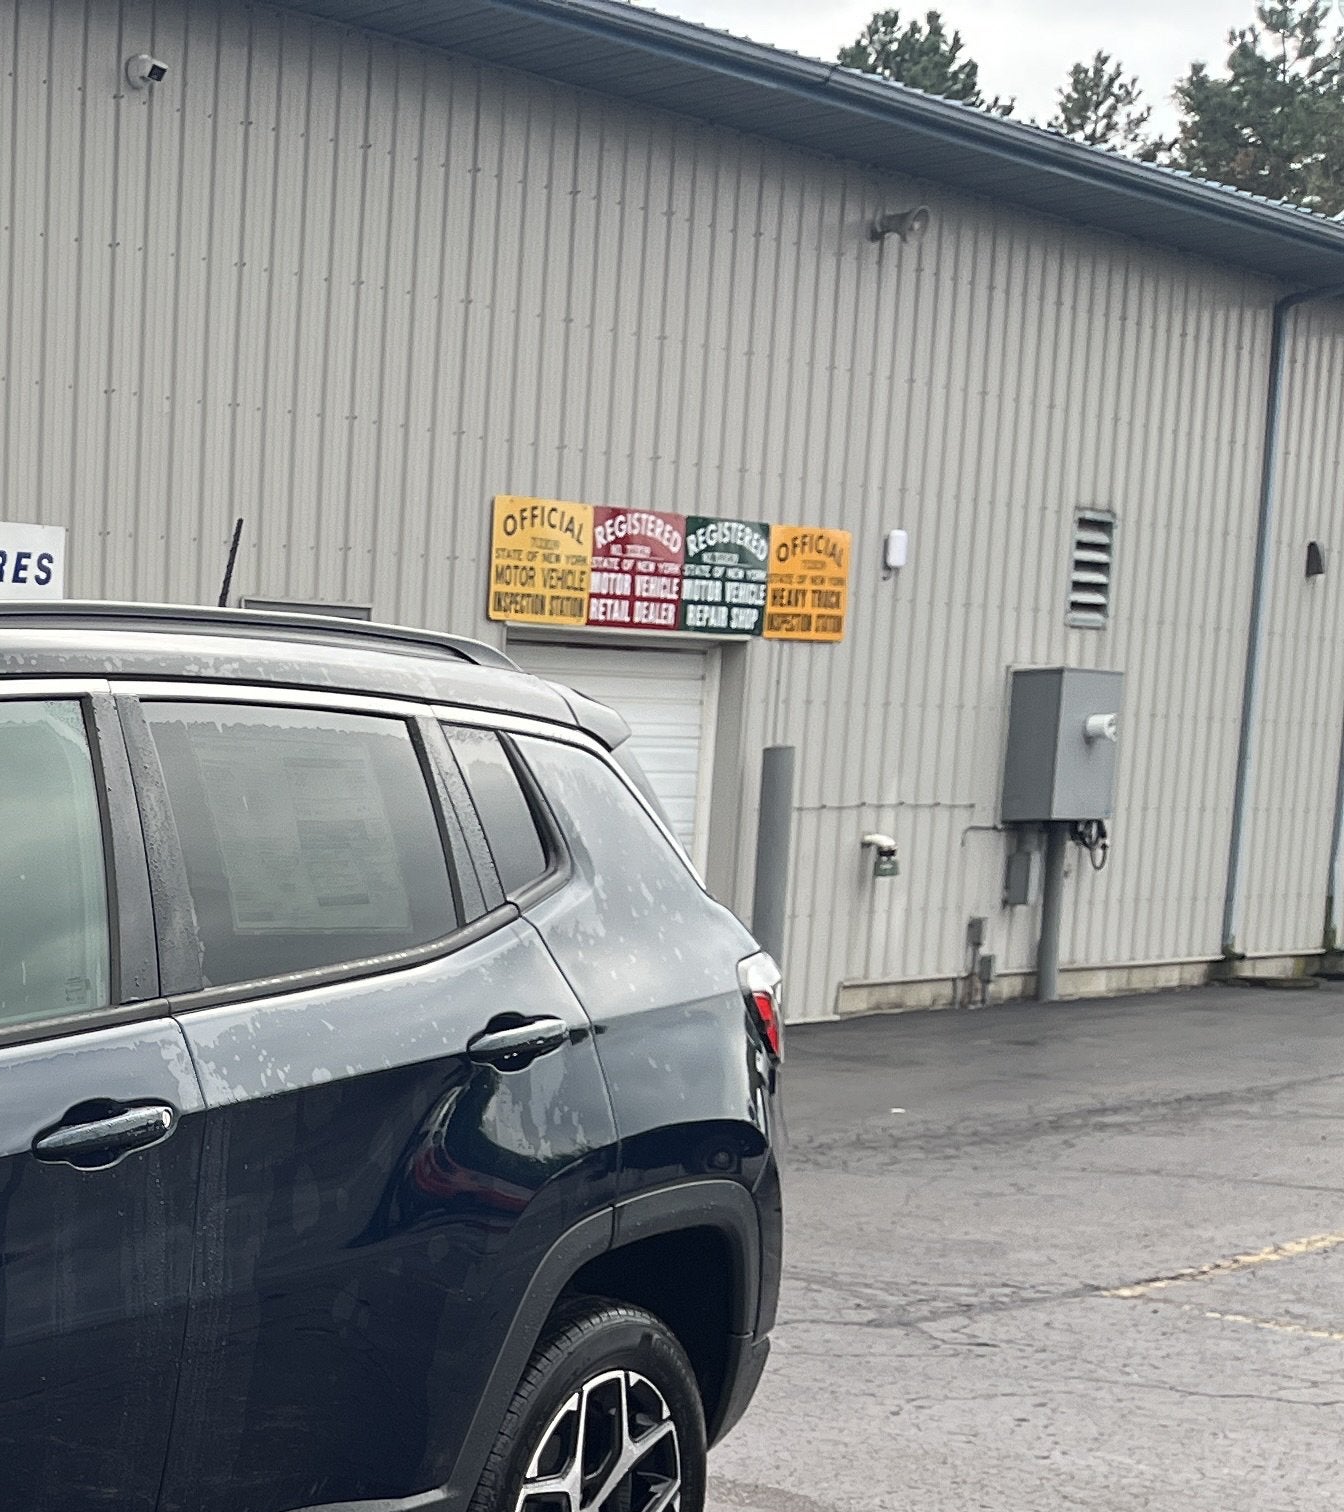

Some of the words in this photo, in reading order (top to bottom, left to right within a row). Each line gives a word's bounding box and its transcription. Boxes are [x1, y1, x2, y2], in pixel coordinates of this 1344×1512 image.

[503, 506, 583, 544] OFFICIAL
[594, 512, 682, 553] REGISTERED
[686, 521, 768, 561] REGISTERED
[776, 533, 843, 567] OFFICIAL
[495, 548, 523, 562] STATE
[527, 550, 539, 562] OF
[542, 552, 561, 564] NEW
[564, 554, 588, 566] YORK
[495, 564, 535, 588] MOTOR
[542, 568, 586, 592] VEHICLE
[590, 571, 631, 596] MOTOR
[634, 574, 680, 599] VEHICLE
[682, 579, 722, 602] MOTOR
[725, 581, 766, 605] VEHICLE
[494, 591, 546, 615] INSPECTION
[548, 595, 584, 618] STATION
[589, 597, 630, 623] RETAIL
[633, 600, 676, 625] DEALER
[771, 588, 807, 608] HEAVY
[686, 604, 728, 628] REPAIR
[730, 607, 759, 630] SHOP
